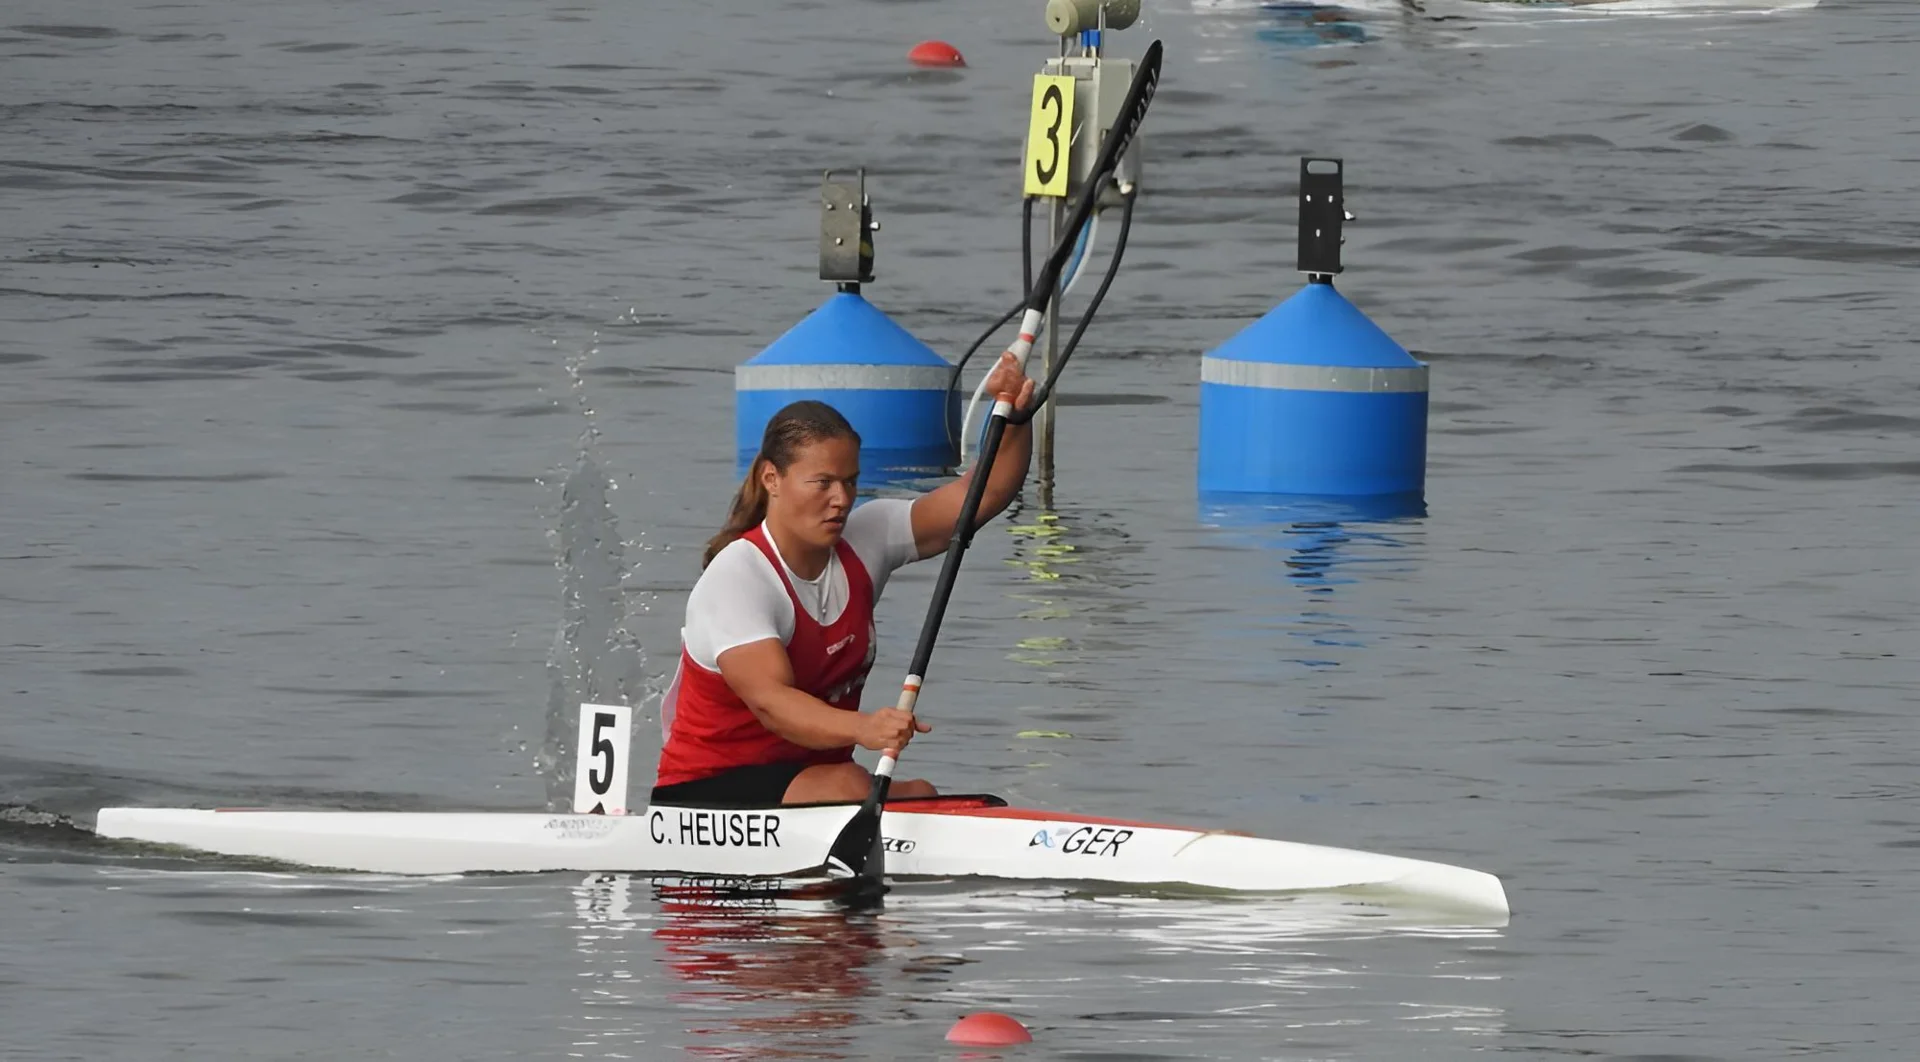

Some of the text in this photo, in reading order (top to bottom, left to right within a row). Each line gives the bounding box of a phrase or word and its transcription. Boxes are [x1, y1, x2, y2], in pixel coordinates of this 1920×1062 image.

[1036, 84, 1063, 185] 3
[588, 712, 616, 795] 5
[650, 811, 673, 845] C.
[679, 811, 781, 848] HEUSER
[1062, 826, 1134, 857] GER
